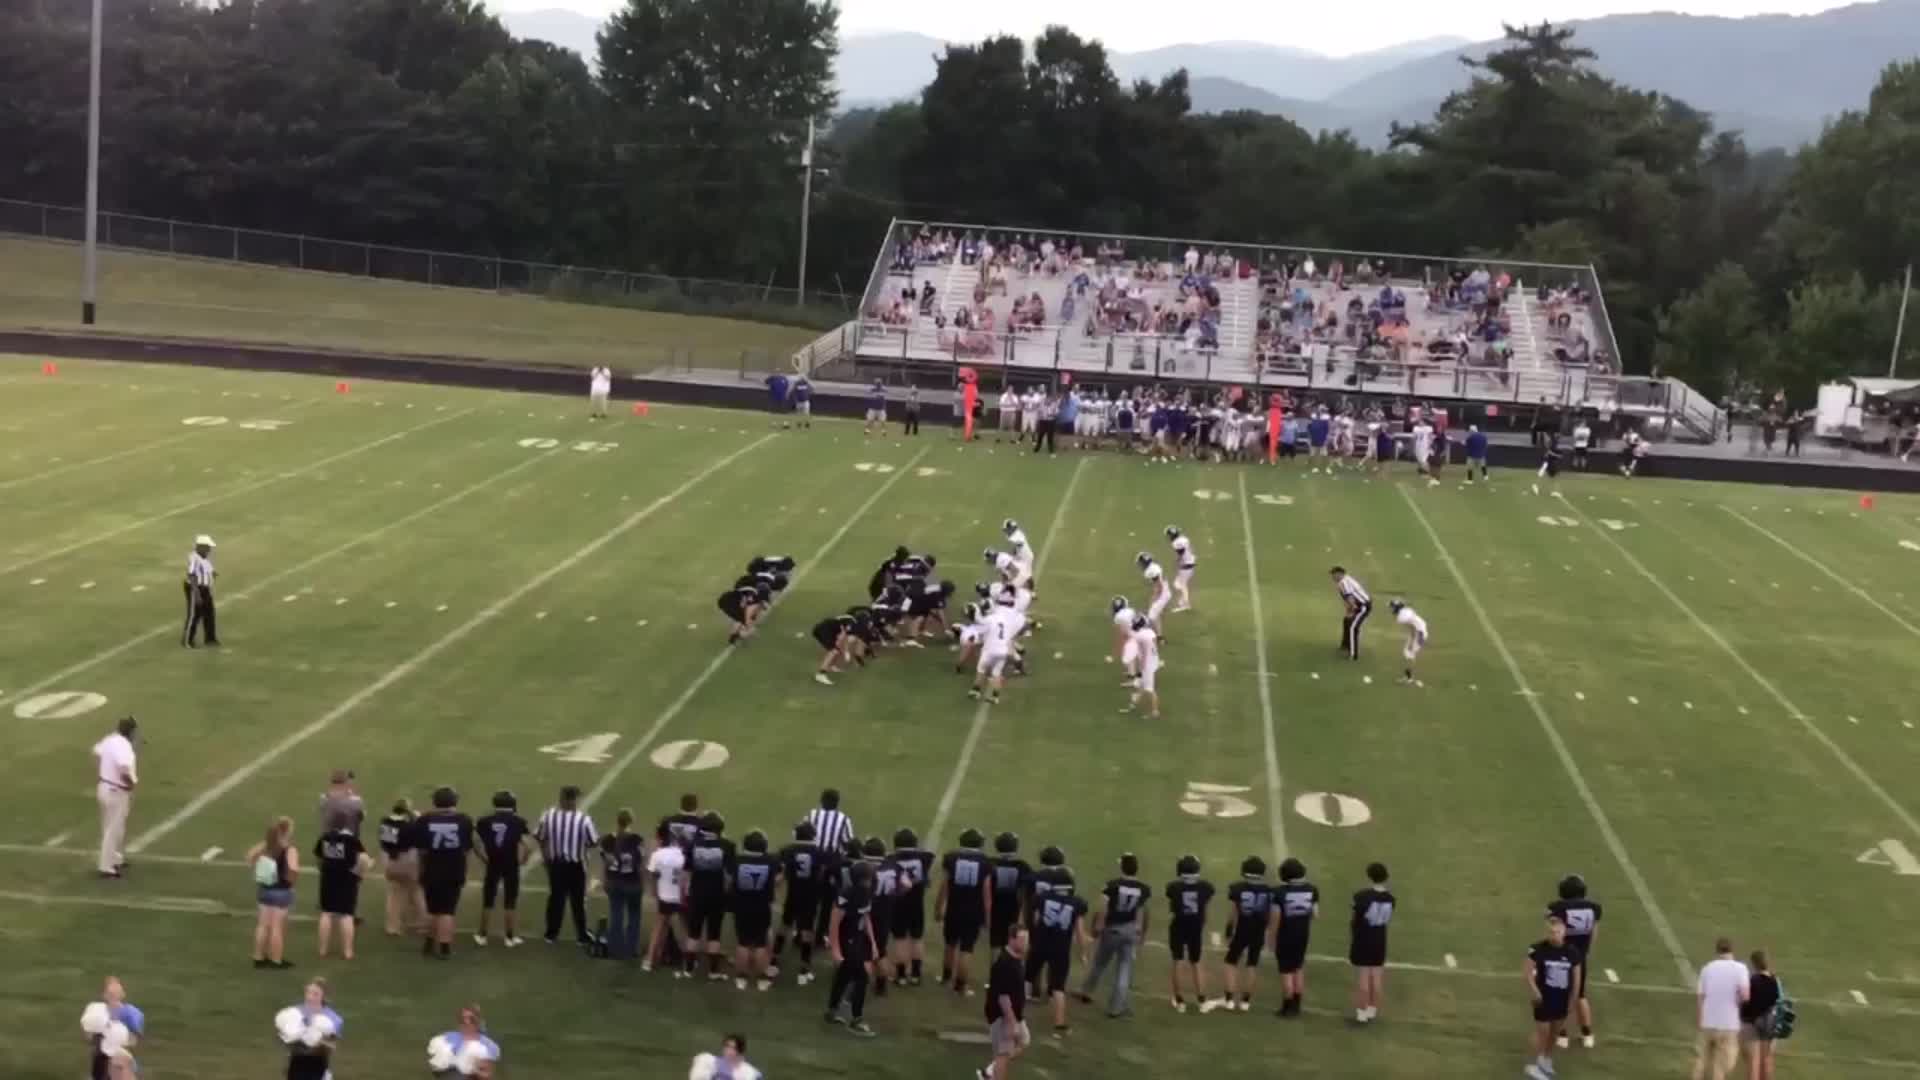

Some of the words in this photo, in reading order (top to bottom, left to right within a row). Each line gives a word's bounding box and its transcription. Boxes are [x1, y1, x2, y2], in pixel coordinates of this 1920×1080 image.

[428, 823, 460, 848] 75
[491, 823, 507, 844] 7
[796, 853, 812, 877] 3
